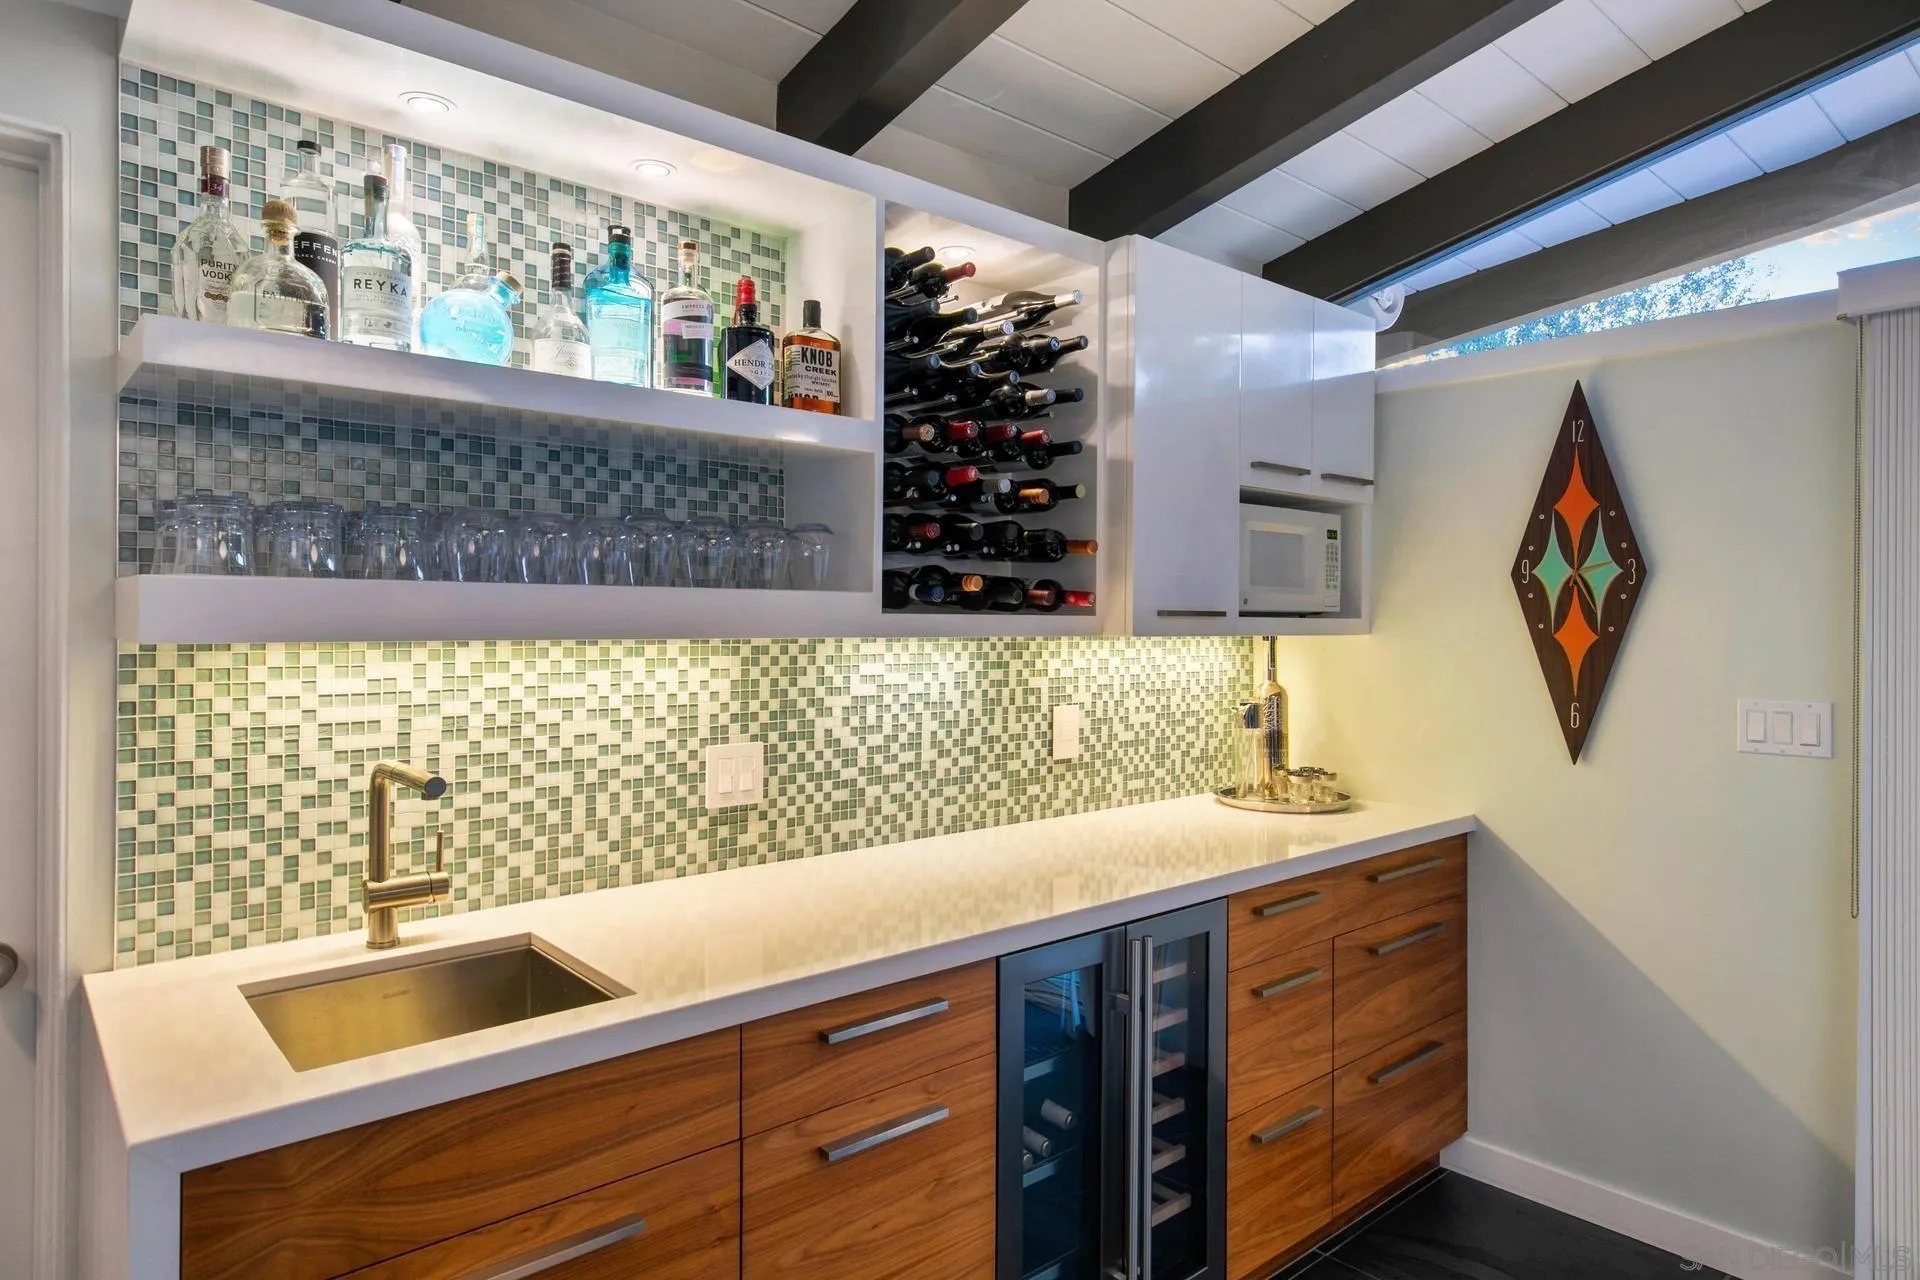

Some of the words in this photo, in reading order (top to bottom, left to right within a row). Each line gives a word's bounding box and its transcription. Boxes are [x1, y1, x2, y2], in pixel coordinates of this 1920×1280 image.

[200, 258, 239, 273] PURITY
[201, 268, 232, 281] VODK
[353, 278, 407, 297] REYKA
[801, 346, 833, 368] KNOB
[805, 365, 837, 377] CREEK
[1572, 419, 1585, 443] 12
[1521, 558, 1530, 584] 9
[1627, 558, 1636, 585] 3
[1570, 702, 1580, 729] 6
